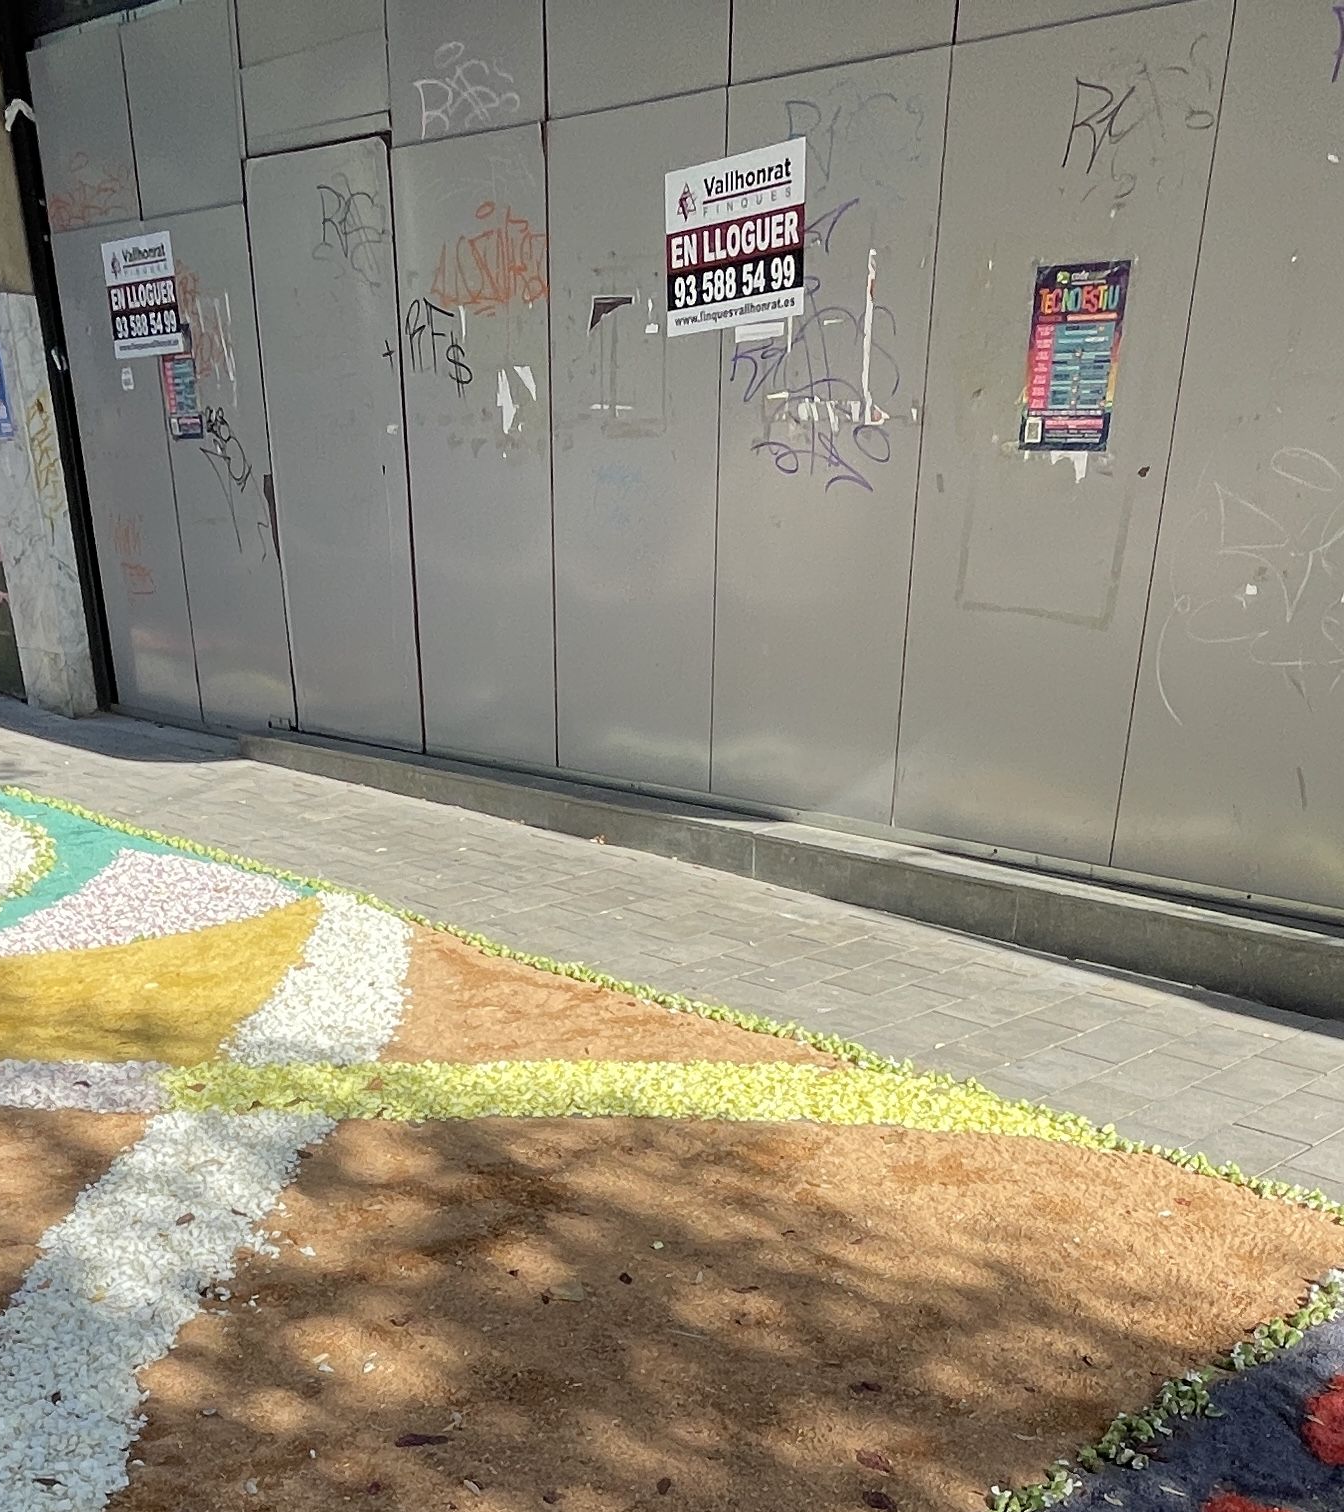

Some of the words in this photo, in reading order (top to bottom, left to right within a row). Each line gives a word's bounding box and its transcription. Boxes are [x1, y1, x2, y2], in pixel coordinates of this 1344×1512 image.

[704, 158, 792, 197] Vallhonrat
[703, 186, 792, 217] FINQUES
[671, 233, 698, 270] EN
[702, 211, 800, 263] LLOGUER
[110, 288, 126, 312] EN
[125, 280, 176, 309] LLOGUER
[674, 274, 698, 308] 93
[702, 266, 737, 303] 588
[742, 260, 766, 296] 54
[771, 254, 796, 290] 99
[115, 315, 129, 339] 93
[149, 311, 164, 335] 54
[163, 309, 177, 333] 99
